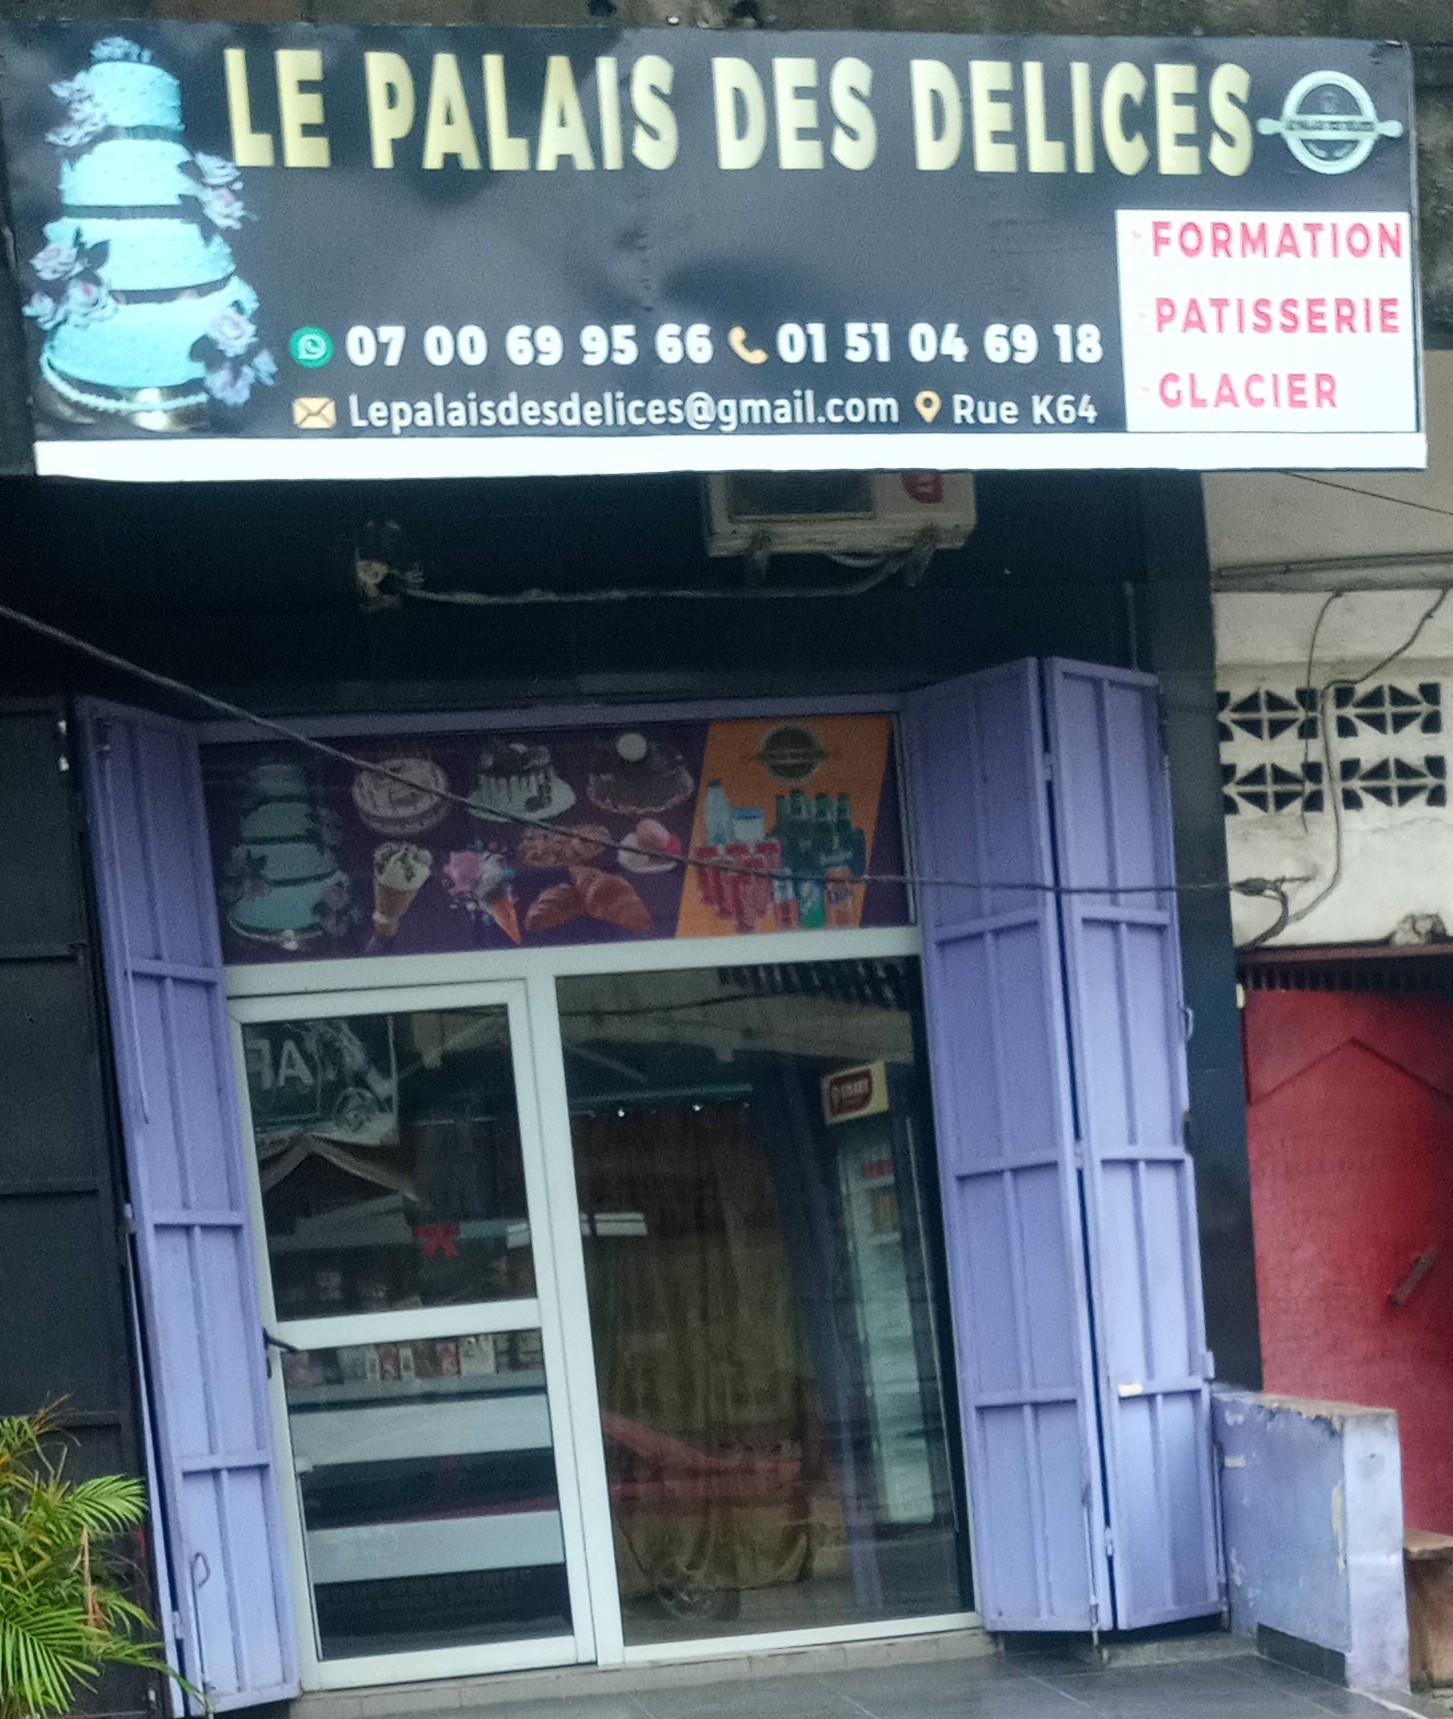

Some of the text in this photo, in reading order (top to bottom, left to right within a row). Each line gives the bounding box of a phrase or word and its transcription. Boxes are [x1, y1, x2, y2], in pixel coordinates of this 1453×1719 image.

[224, 48, 1254, 176] LE PALAIS DES DELICES
[1151, 220, 1403, 259] FORMATION
[1154, 296, 1400, 334] PATISSERIE
[345, 322, 714, 367] 07 00 69 95 66
[776, 322, 1103, 364] 01 51 04 69 18
[952, 393, 1099, 426] Rue K64
[1158, 371, 1338, 409] GLACIER
[349, 390, 899, 434] Lepalaisdesdelices@gmail.com
